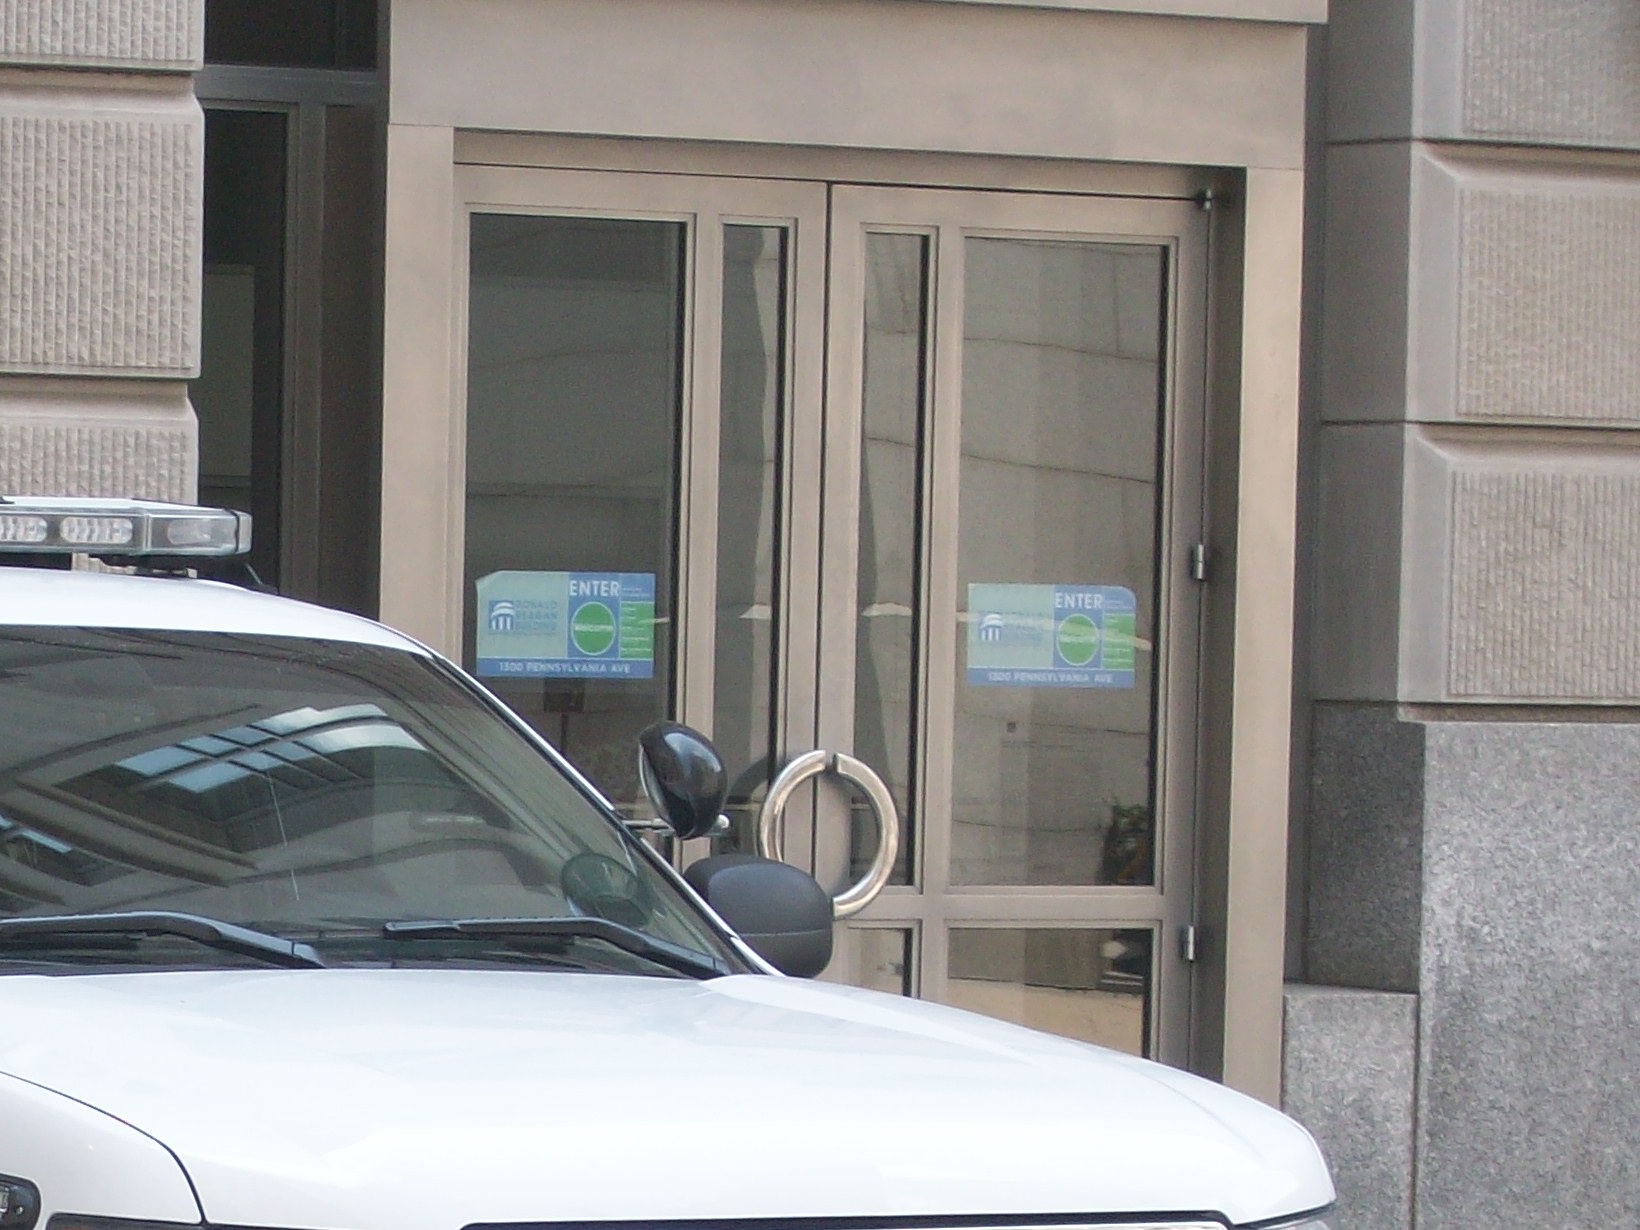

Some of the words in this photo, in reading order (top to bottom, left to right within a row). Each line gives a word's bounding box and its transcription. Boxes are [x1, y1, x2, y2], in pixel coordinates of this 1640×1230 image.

[569, 580, 620, 598] ENTER
[1055, 592, 1103, 609] ENTER
[526, 662, 607, 673] PENNSYLVANIA
[611, 663, 631, 674] AVE
